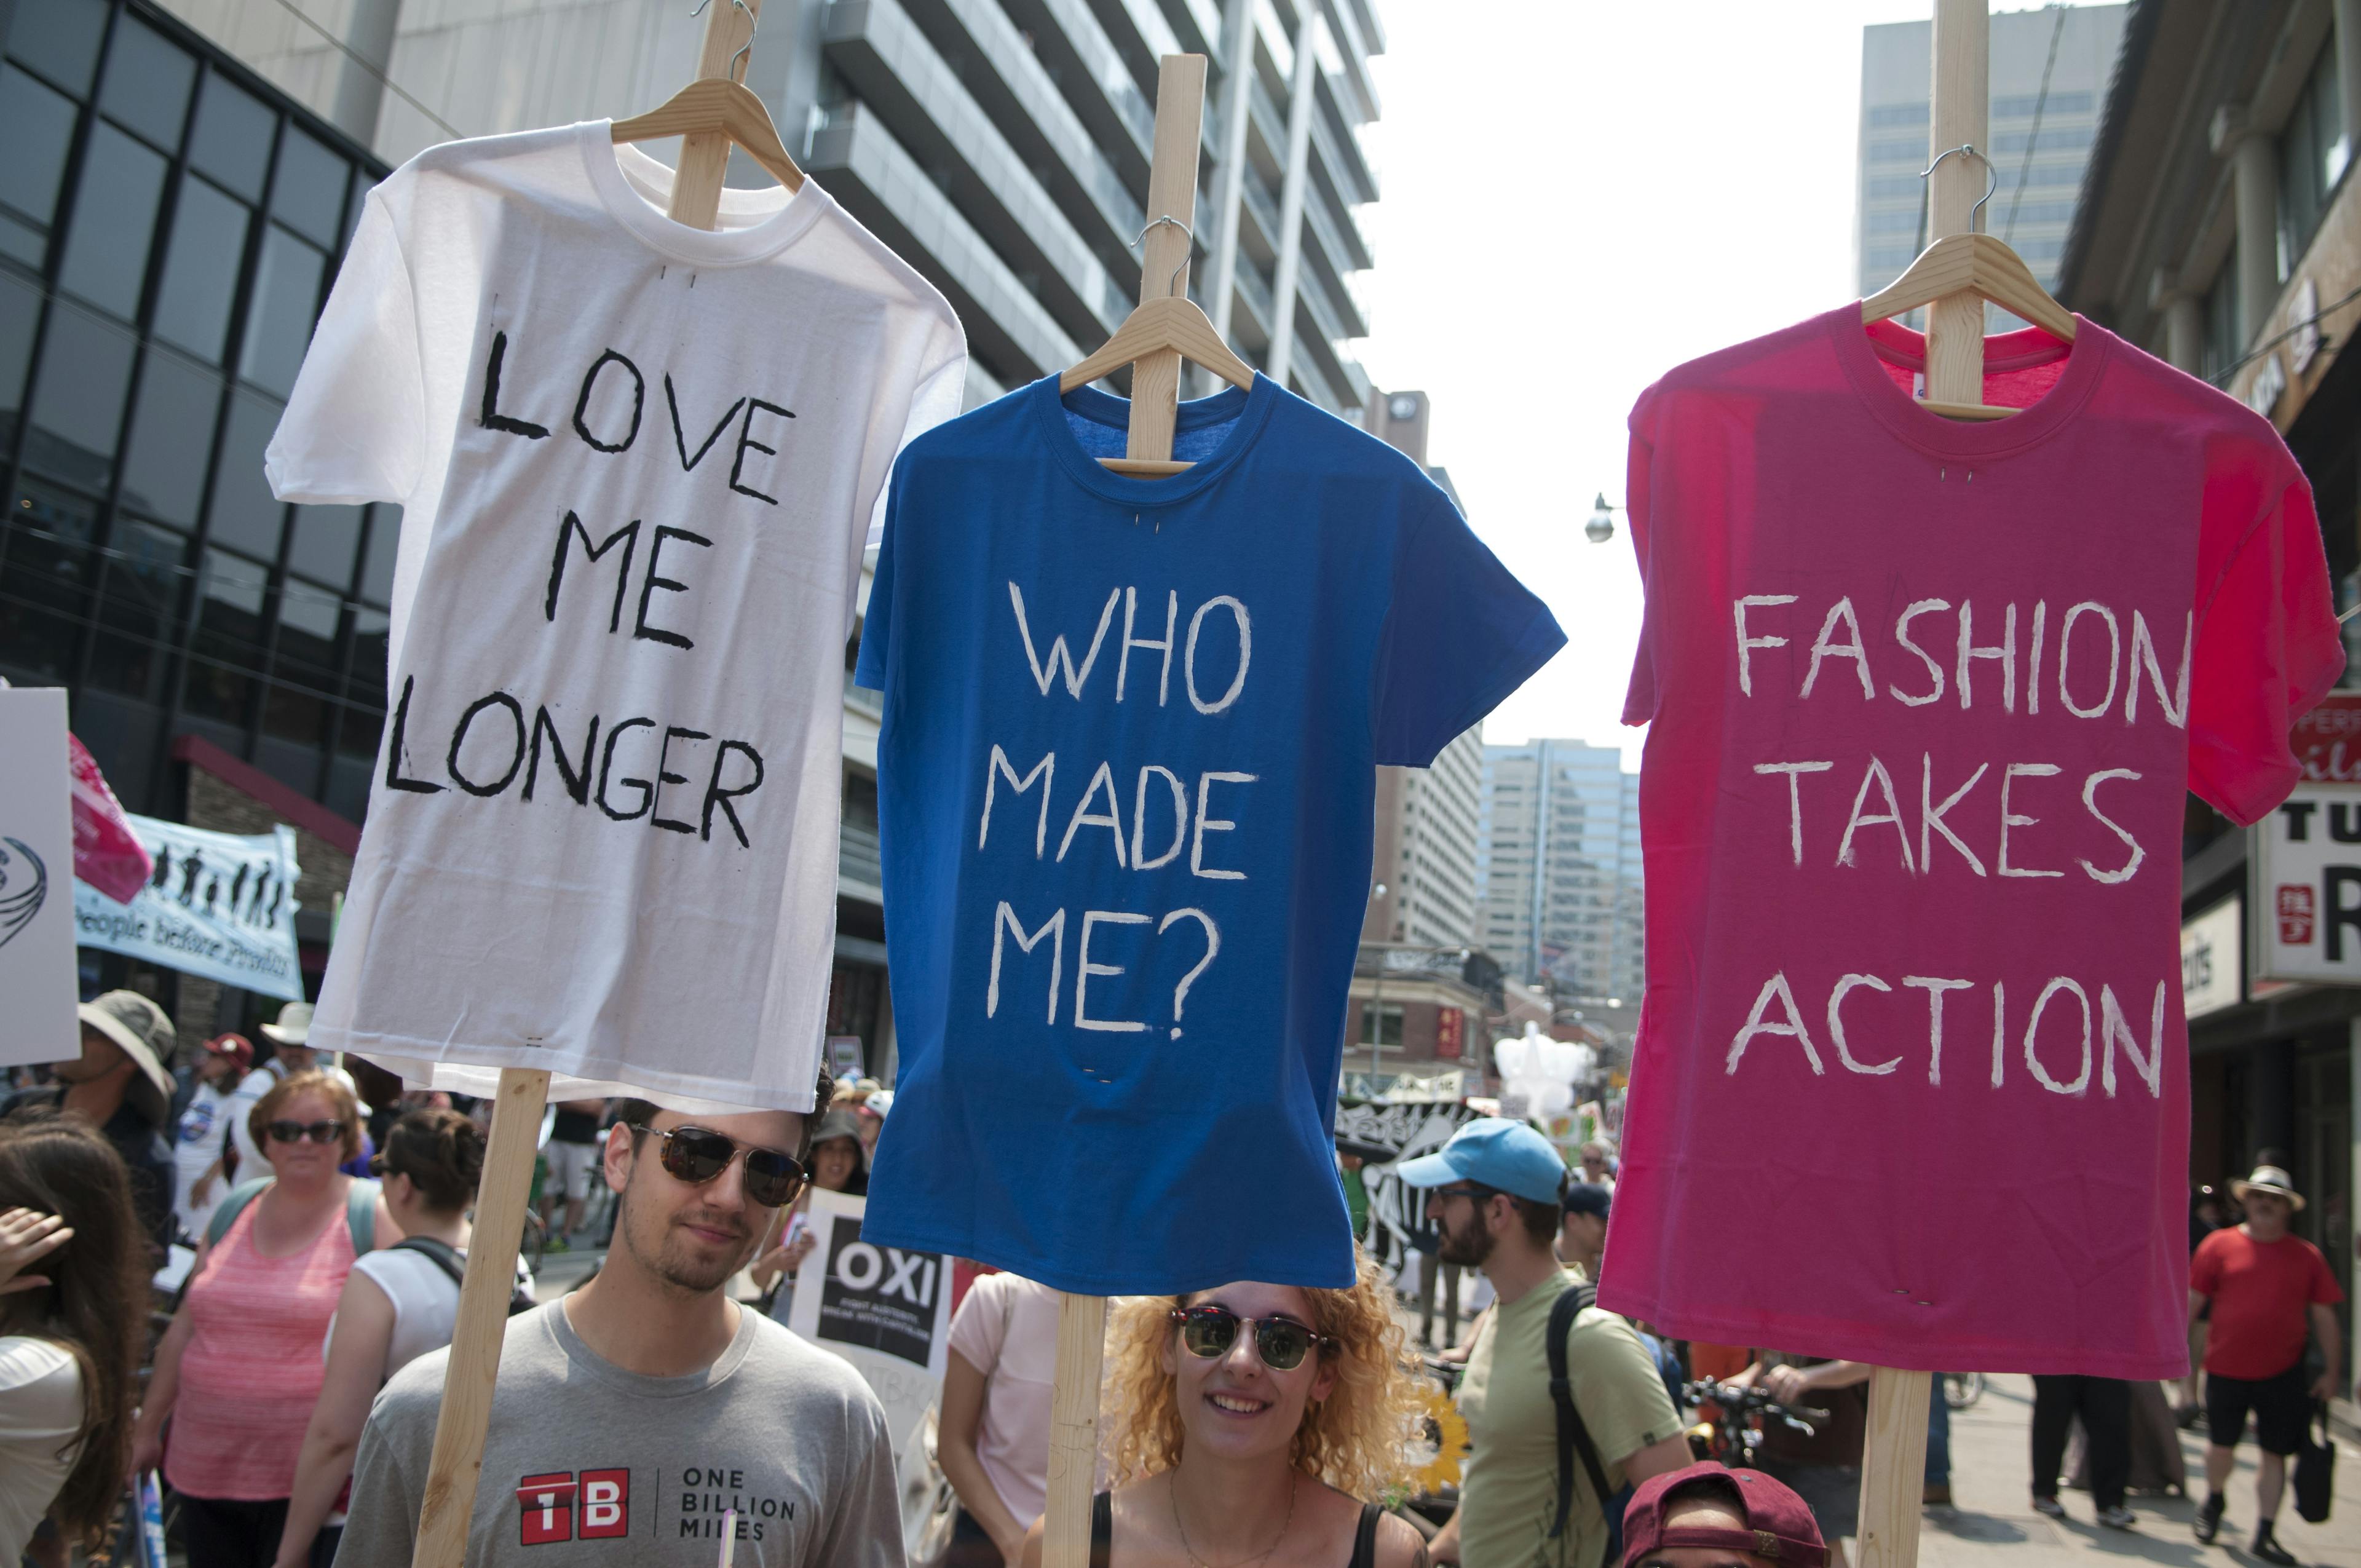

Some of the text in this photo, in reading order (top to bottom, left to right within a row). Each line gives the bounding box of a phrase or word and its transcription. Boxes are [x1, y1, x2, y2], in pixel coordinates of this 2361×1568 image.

[478, 331, 797, 505] LOVE
[545, 510, 715, 650] ME
[1008, 580, 1251, 715] WHO
[1733, 594, 2193, 729] FASHION
[386, 674, 764, 849] LONGER
[979, 744, 1257, 879] MADE
[1753, 751, 2146, 884] TAKES
[987, 901, 1221, 1040] ME?
[1726, 970, 2166, 1099] ACTION
[836, 1241, 936, 1309] OXI
[682, 1467, 743, 1489] ONE
[682, 1492, 795, 1521] BILLION
